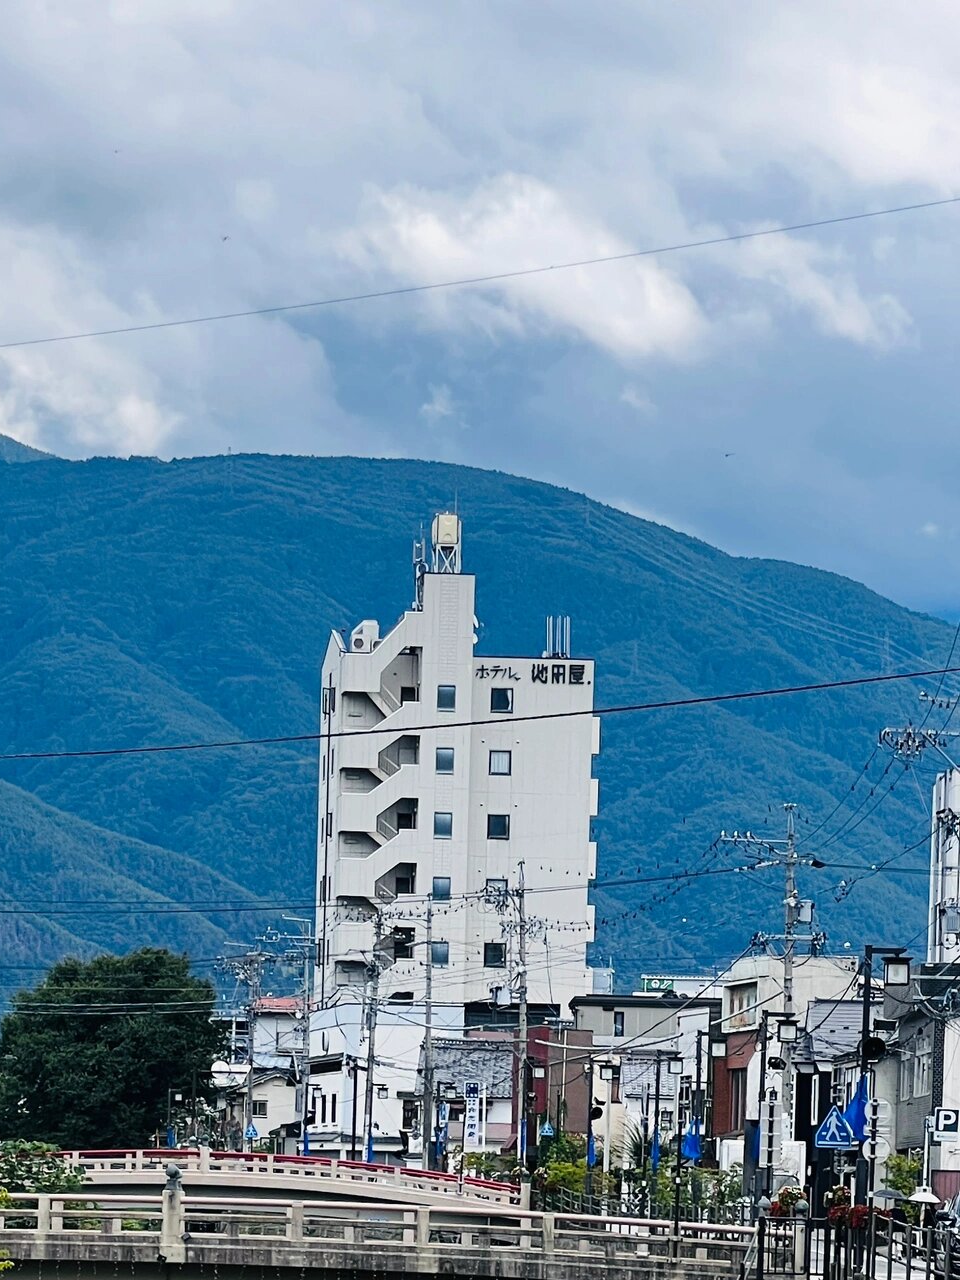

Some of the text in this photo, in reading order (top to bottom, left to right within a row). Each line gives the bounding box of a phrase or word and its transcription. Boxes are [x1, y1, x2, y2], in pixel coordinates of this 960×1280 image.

[531, 664, 585, 685] 池田屋
[939, 1111, 956, 1130] P
